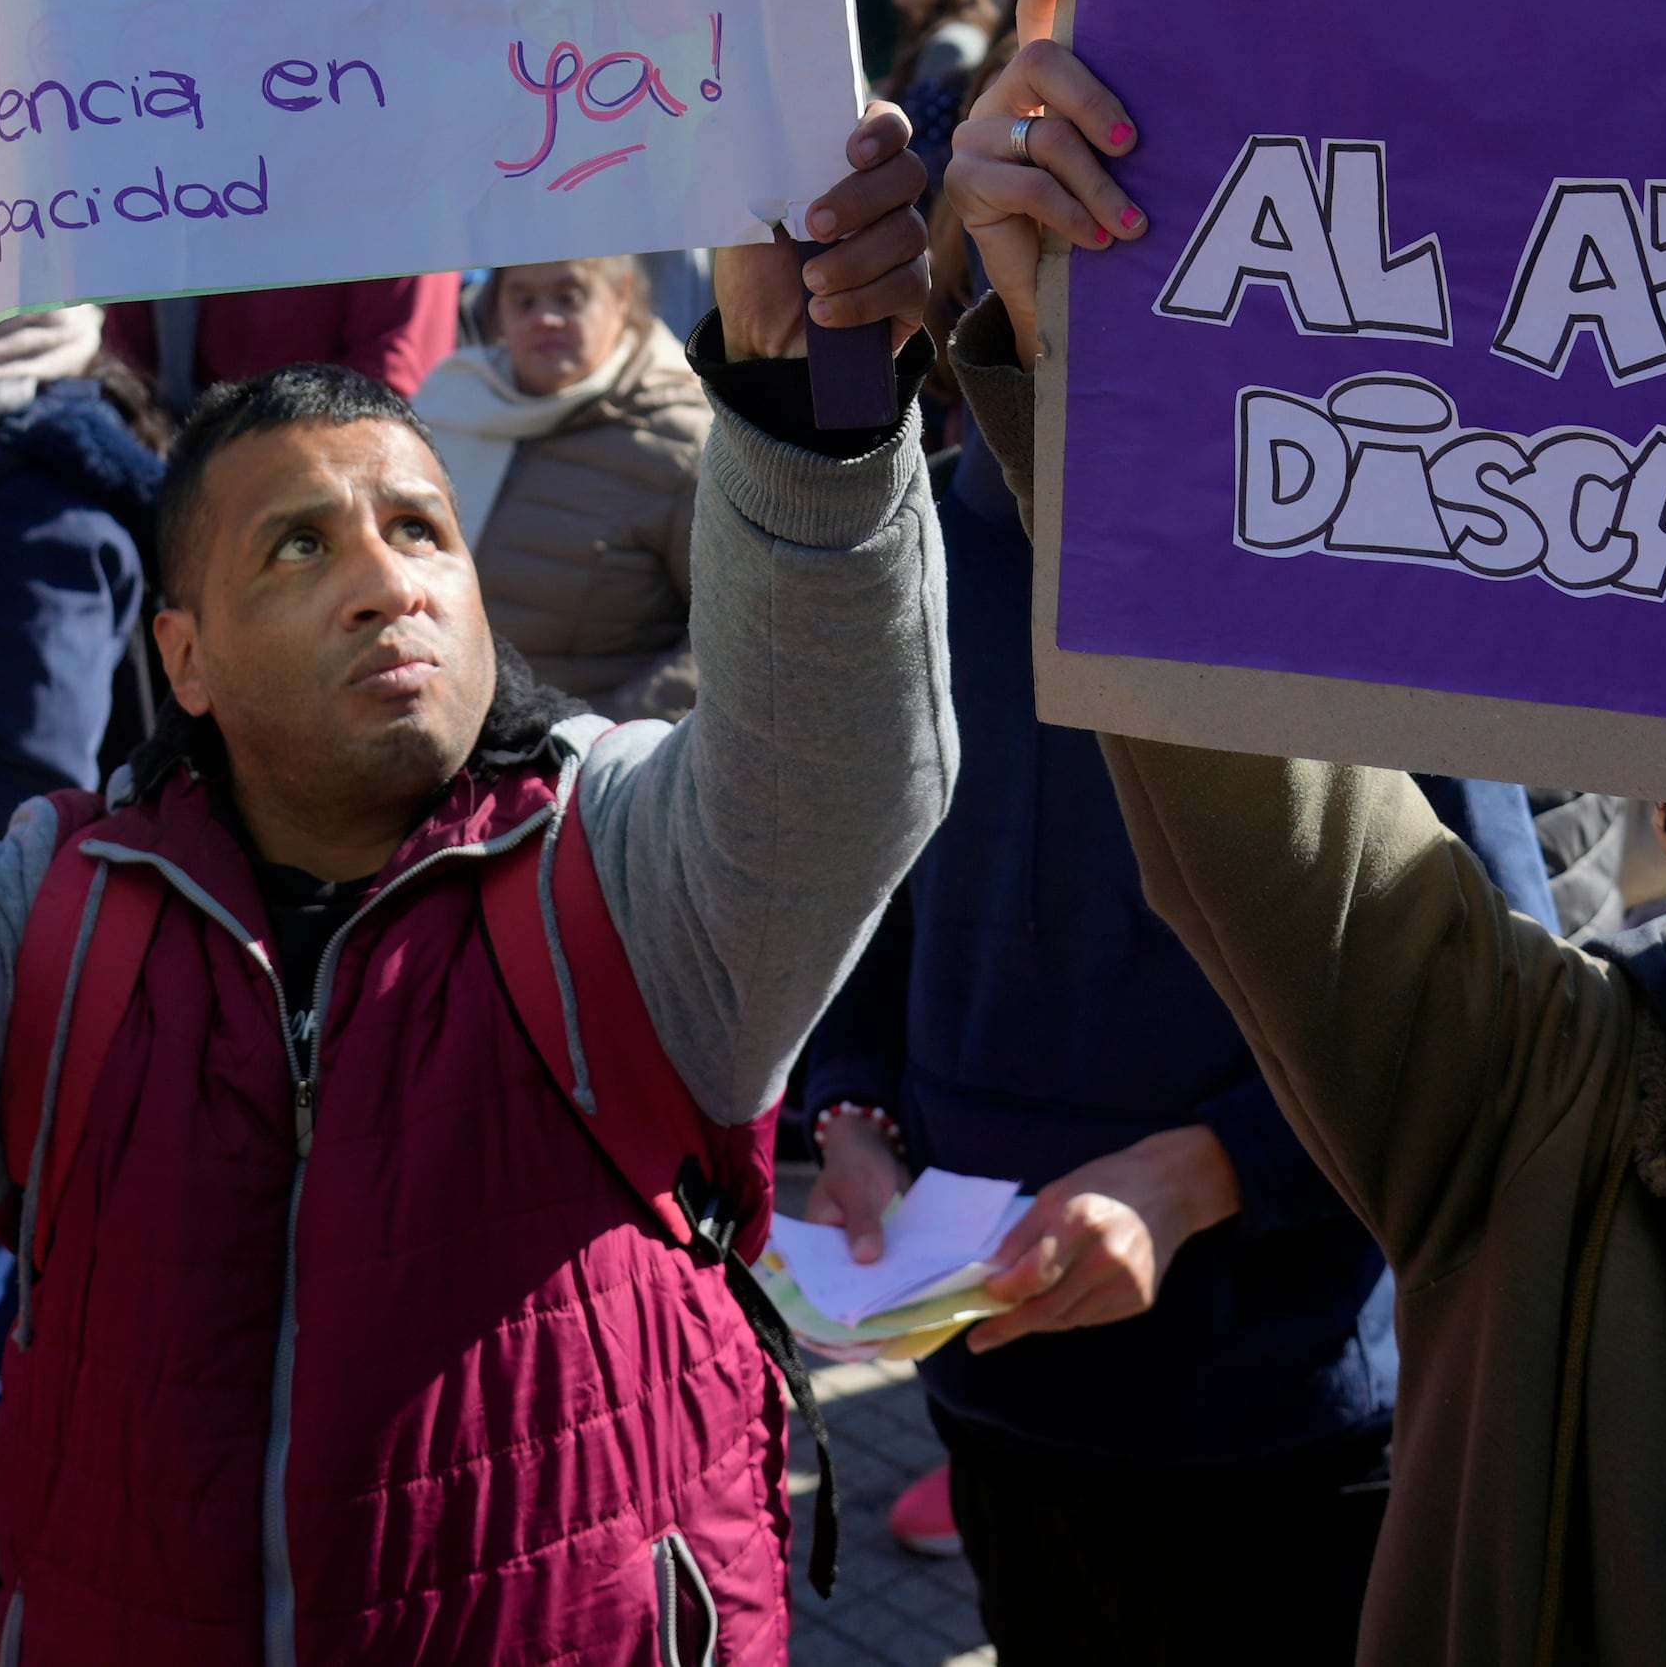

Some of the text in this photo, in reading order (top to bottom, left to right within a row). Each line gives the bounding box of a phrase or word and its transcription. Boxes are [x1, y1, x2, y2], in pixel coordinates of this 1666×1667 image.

[261, 57, 386, 112] en
[493, 10, 723, 179] ya!
[1157, 135, 1450, 341] AL
